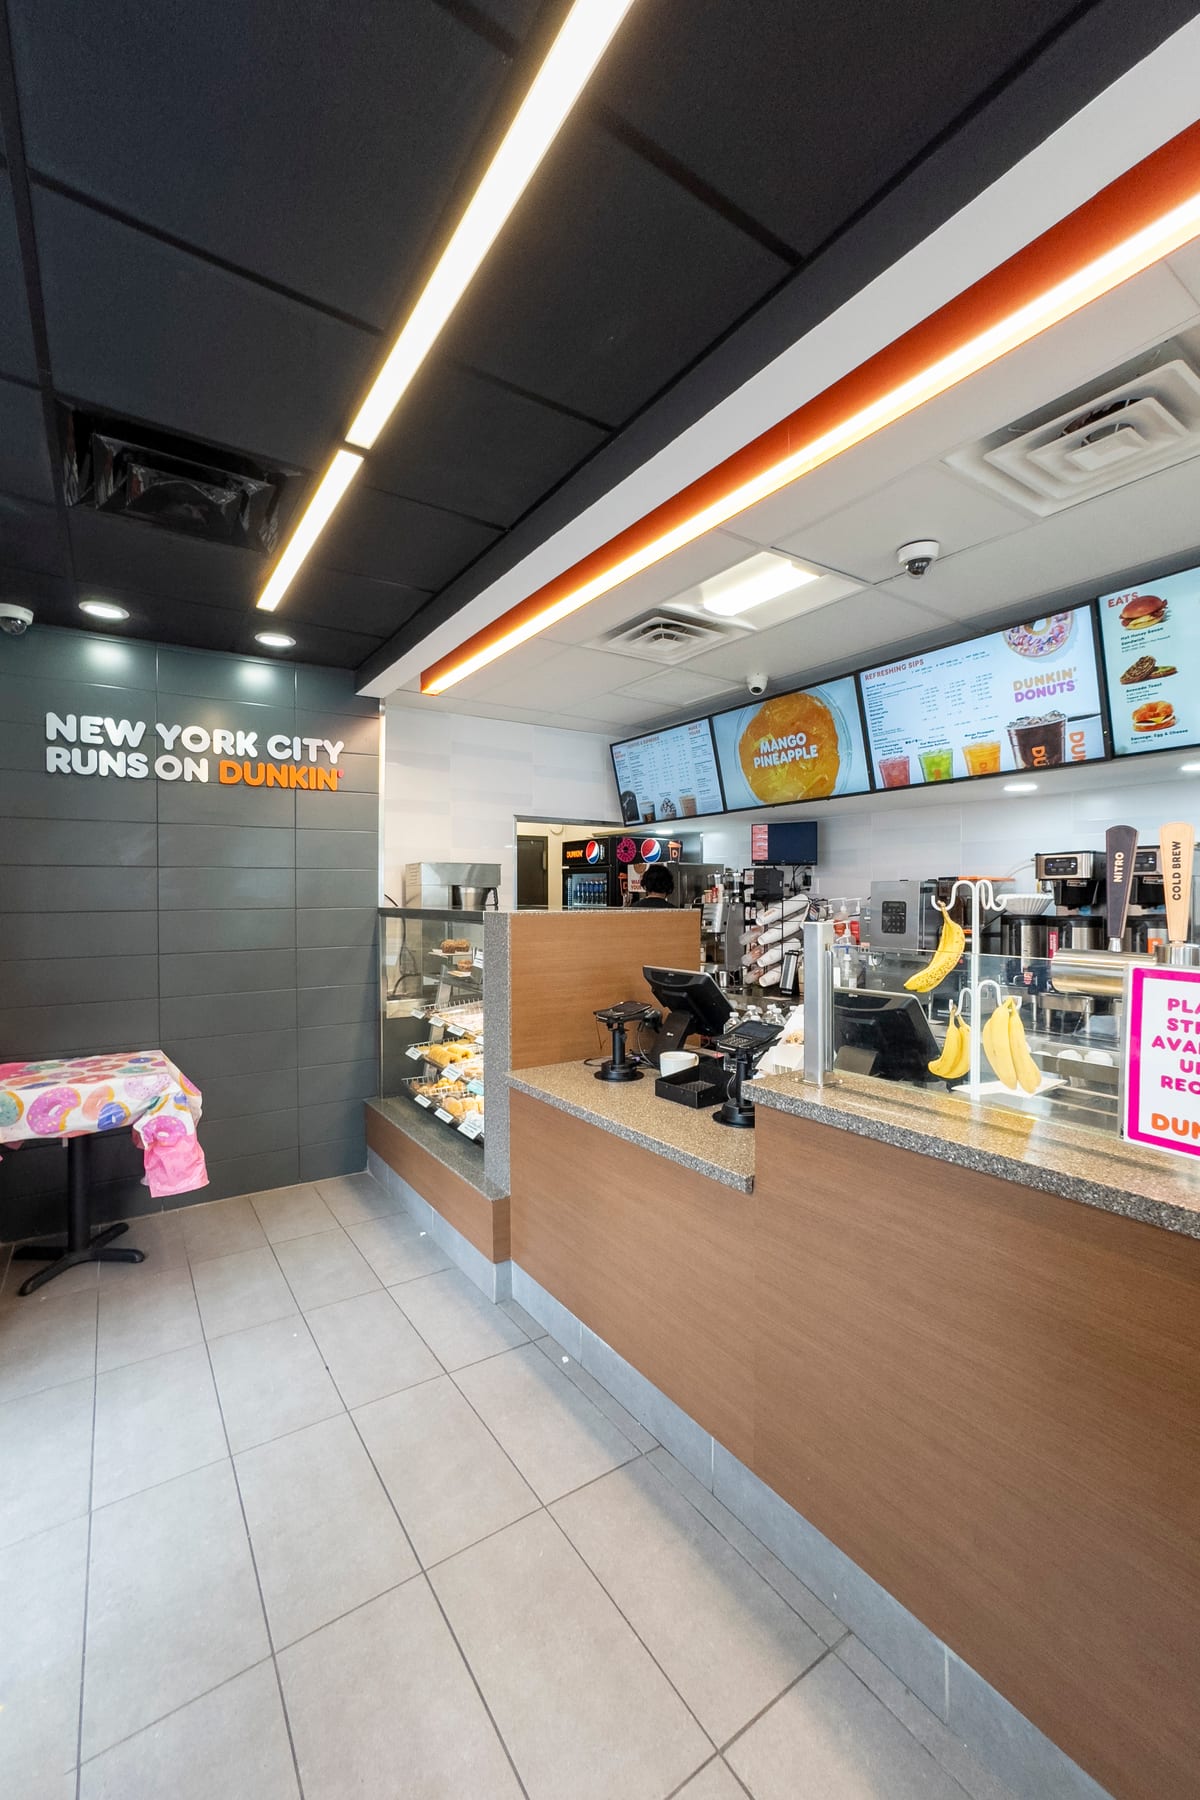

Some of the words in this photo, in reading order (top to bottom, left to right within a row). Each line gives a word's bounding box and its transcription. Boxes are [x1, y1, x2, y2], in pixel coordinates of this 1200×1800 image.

[1108, 592, 1139, 608] EATS
[864, 664, 907, 681] REFRESHING
[908, 659, 924, 669] SIPS
[1013, 666, 1077, 691] DUNKIN'
[1014, 680, 1075, 703] DONUTS
[46, 712, 146, 748] NEW
[156, 722, 258, 758] YORK
[266, 734, 345, 764] CITY
[760, 732, 807, 754] MANGO
[46, 746, 149, 779] RUNS
[154, 755, 209, 783] ON
[219, 759, 345, 791] DUNKIN'
[753, 744, 819, 769] PINEAPPLE
[1113, 851, 1125, 883] NITRO
[1171, 841, 1181, 869] BREW
[1172, 872, 1182, 901] COLD
[1151, 1035, 1200, 1055] AVA
